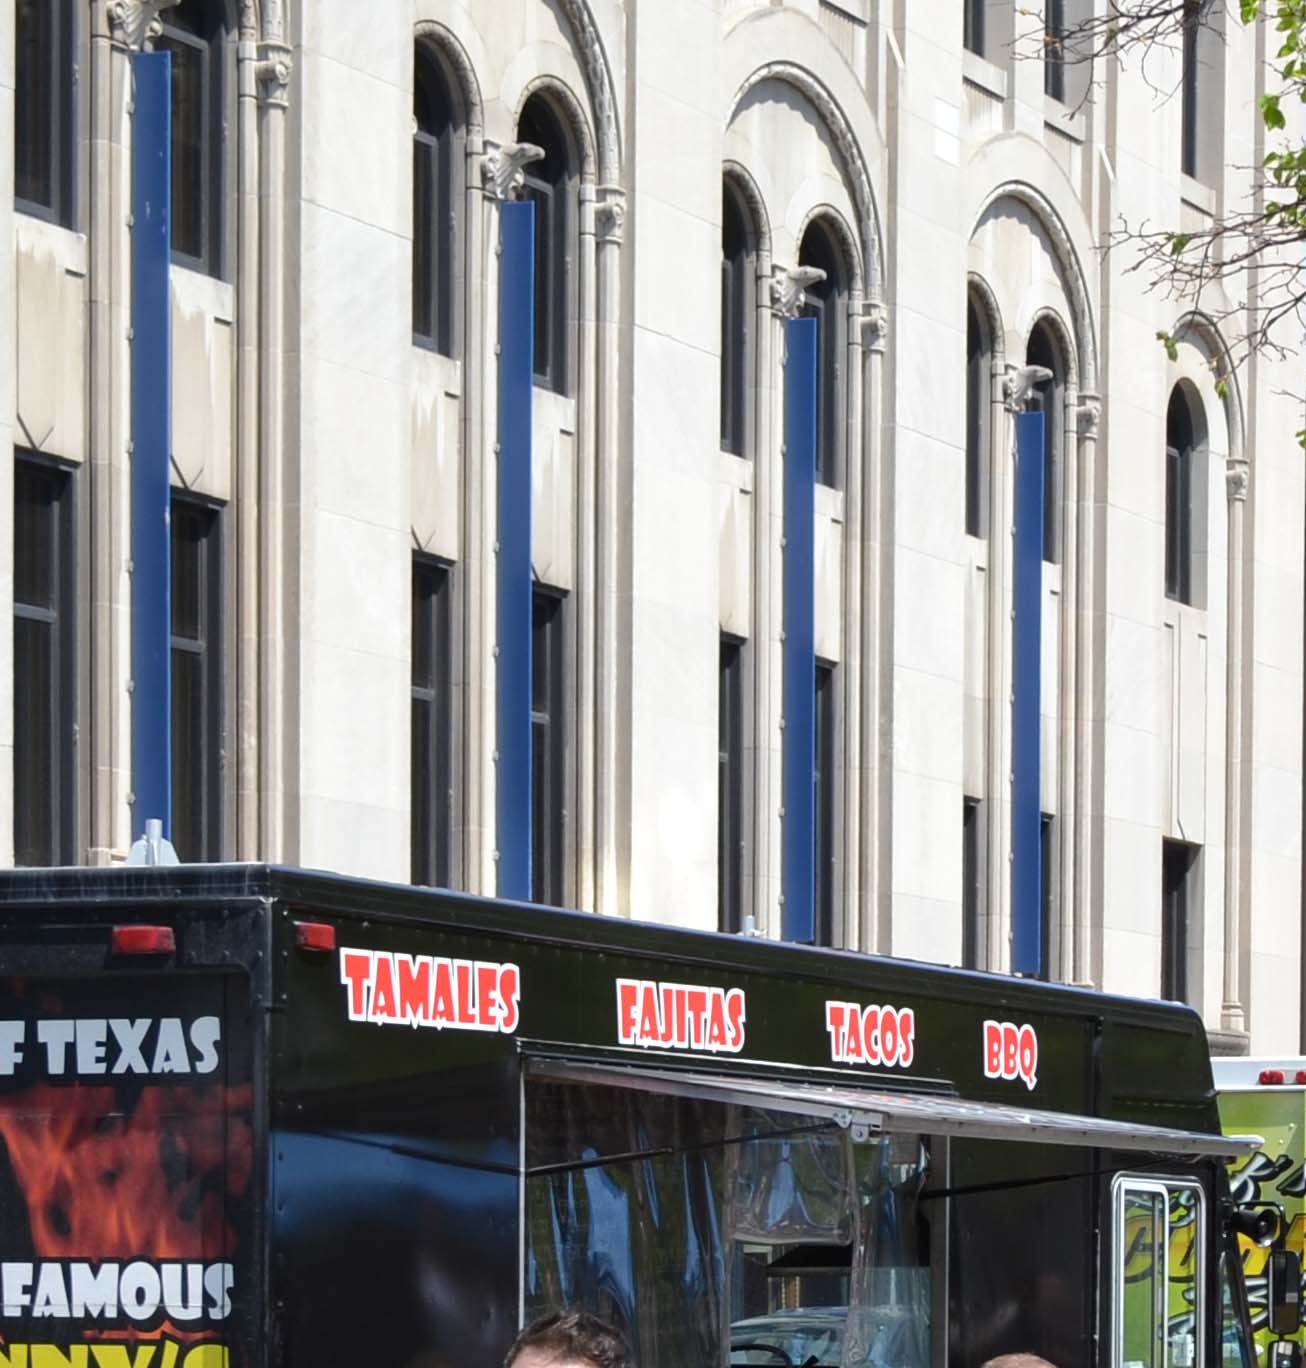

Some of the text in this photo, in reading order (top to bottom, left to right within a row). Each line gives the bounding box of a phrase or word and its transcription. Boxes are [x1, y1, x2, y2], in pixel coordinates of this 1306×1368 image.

[37, 1016, 221, 1075] TEXAS
[339, 947, 1039, 1091] TAMALES FAJITAS TACOS BBQ
[1, 1261, 234, 1320] FAMOUS
